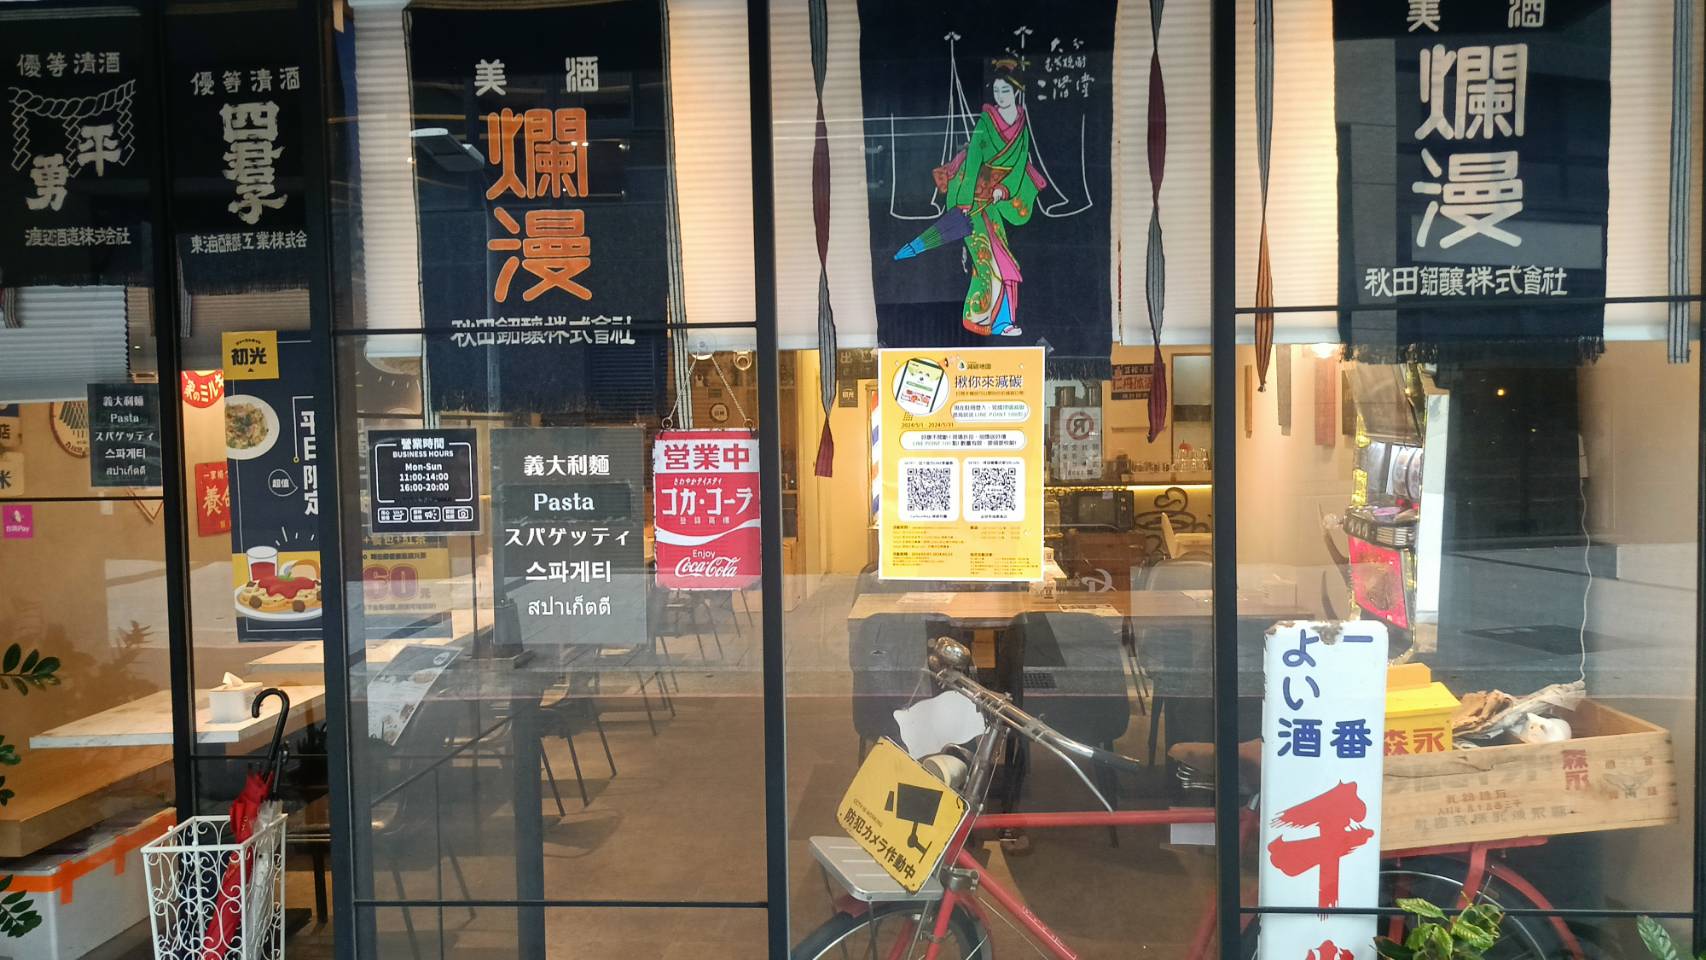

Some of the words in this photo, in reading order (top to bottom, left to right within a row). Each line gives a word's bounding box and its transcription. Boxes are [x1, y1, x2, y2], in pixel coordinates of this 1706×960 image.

[16, 51, 121, 79] 優等清酒
[190, 65, 301, 97] 優等清酒
[230, 346, 268, 366] 初光
[955, 374, 1023, 389] 揪你來減碳
[110, 412, 140, 424] Pasta
[95, 431, 155, 442] スパゲッティ
[104, 447, 146, 460] 스파게티
[392, 451, 427, 459] BUSINESS
[664, 443, 751, 471] 営業中
[405, 462, 443, 471] Mon-Sun
[523, 454, 612, 476] 義大利麵
[399, 473, 449, 482] 11:00-14:00
[399, 483, 450, 491] 16:00-20:00
[534, 492, 595, 512] Pasta
[505, 527, 630, 546] スパゲッティ
[692, 550, 716, 559] Enjoy
[525, 560, 611, 583] 스파게티
[675, 556, 741, 578] Coca-Cola
[843, 807, 917, 879] 防犯カメラ作動中
